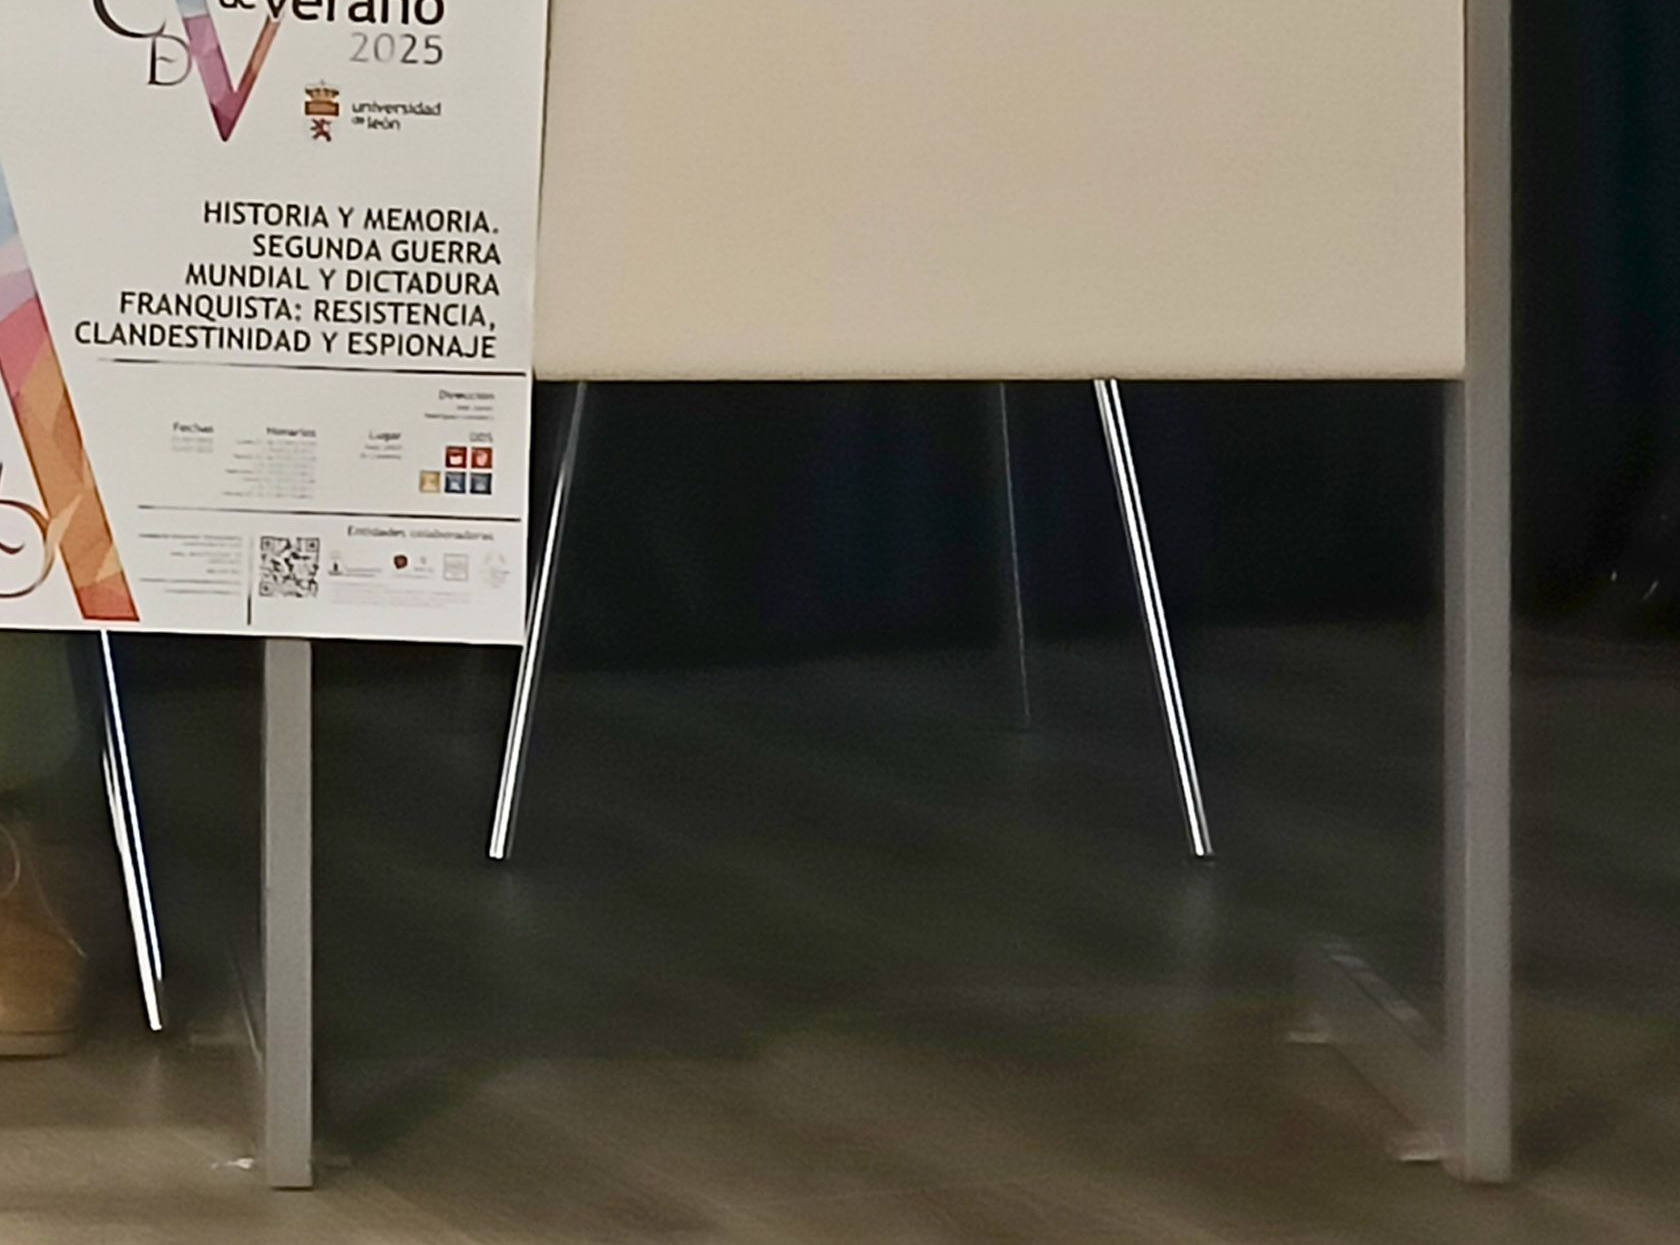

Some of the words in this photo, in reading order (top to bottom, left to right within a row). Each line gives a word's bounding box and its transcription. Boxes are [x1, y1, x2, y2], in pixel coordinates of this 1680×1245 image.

[349, 32, 444, 66] 2025
[351, 103, 442, 116] universidad
[368, 116, 400, 130] león
[204, 200, 329, 229] HISTORIA
[338, 206, 354, 229] Y
[252, 233, 382, 262] SEGUNDA
[391, 239, 502, 265] GUERRA
[185, 263, 310, 291] MUNDIAL
[319, 268, 336, 291] Y
[346, 270, 500, 296] DICTADURA
[120, 291, 302, 323] FRANQUISTA:
[314, 298, 496, 332] RESISTENCIA,
[74, 320, 311, 353] CLANDESTINIDAD
[322, 331, 338, 353] Y
[348, 331, 497, 359] ESPIONAJE
